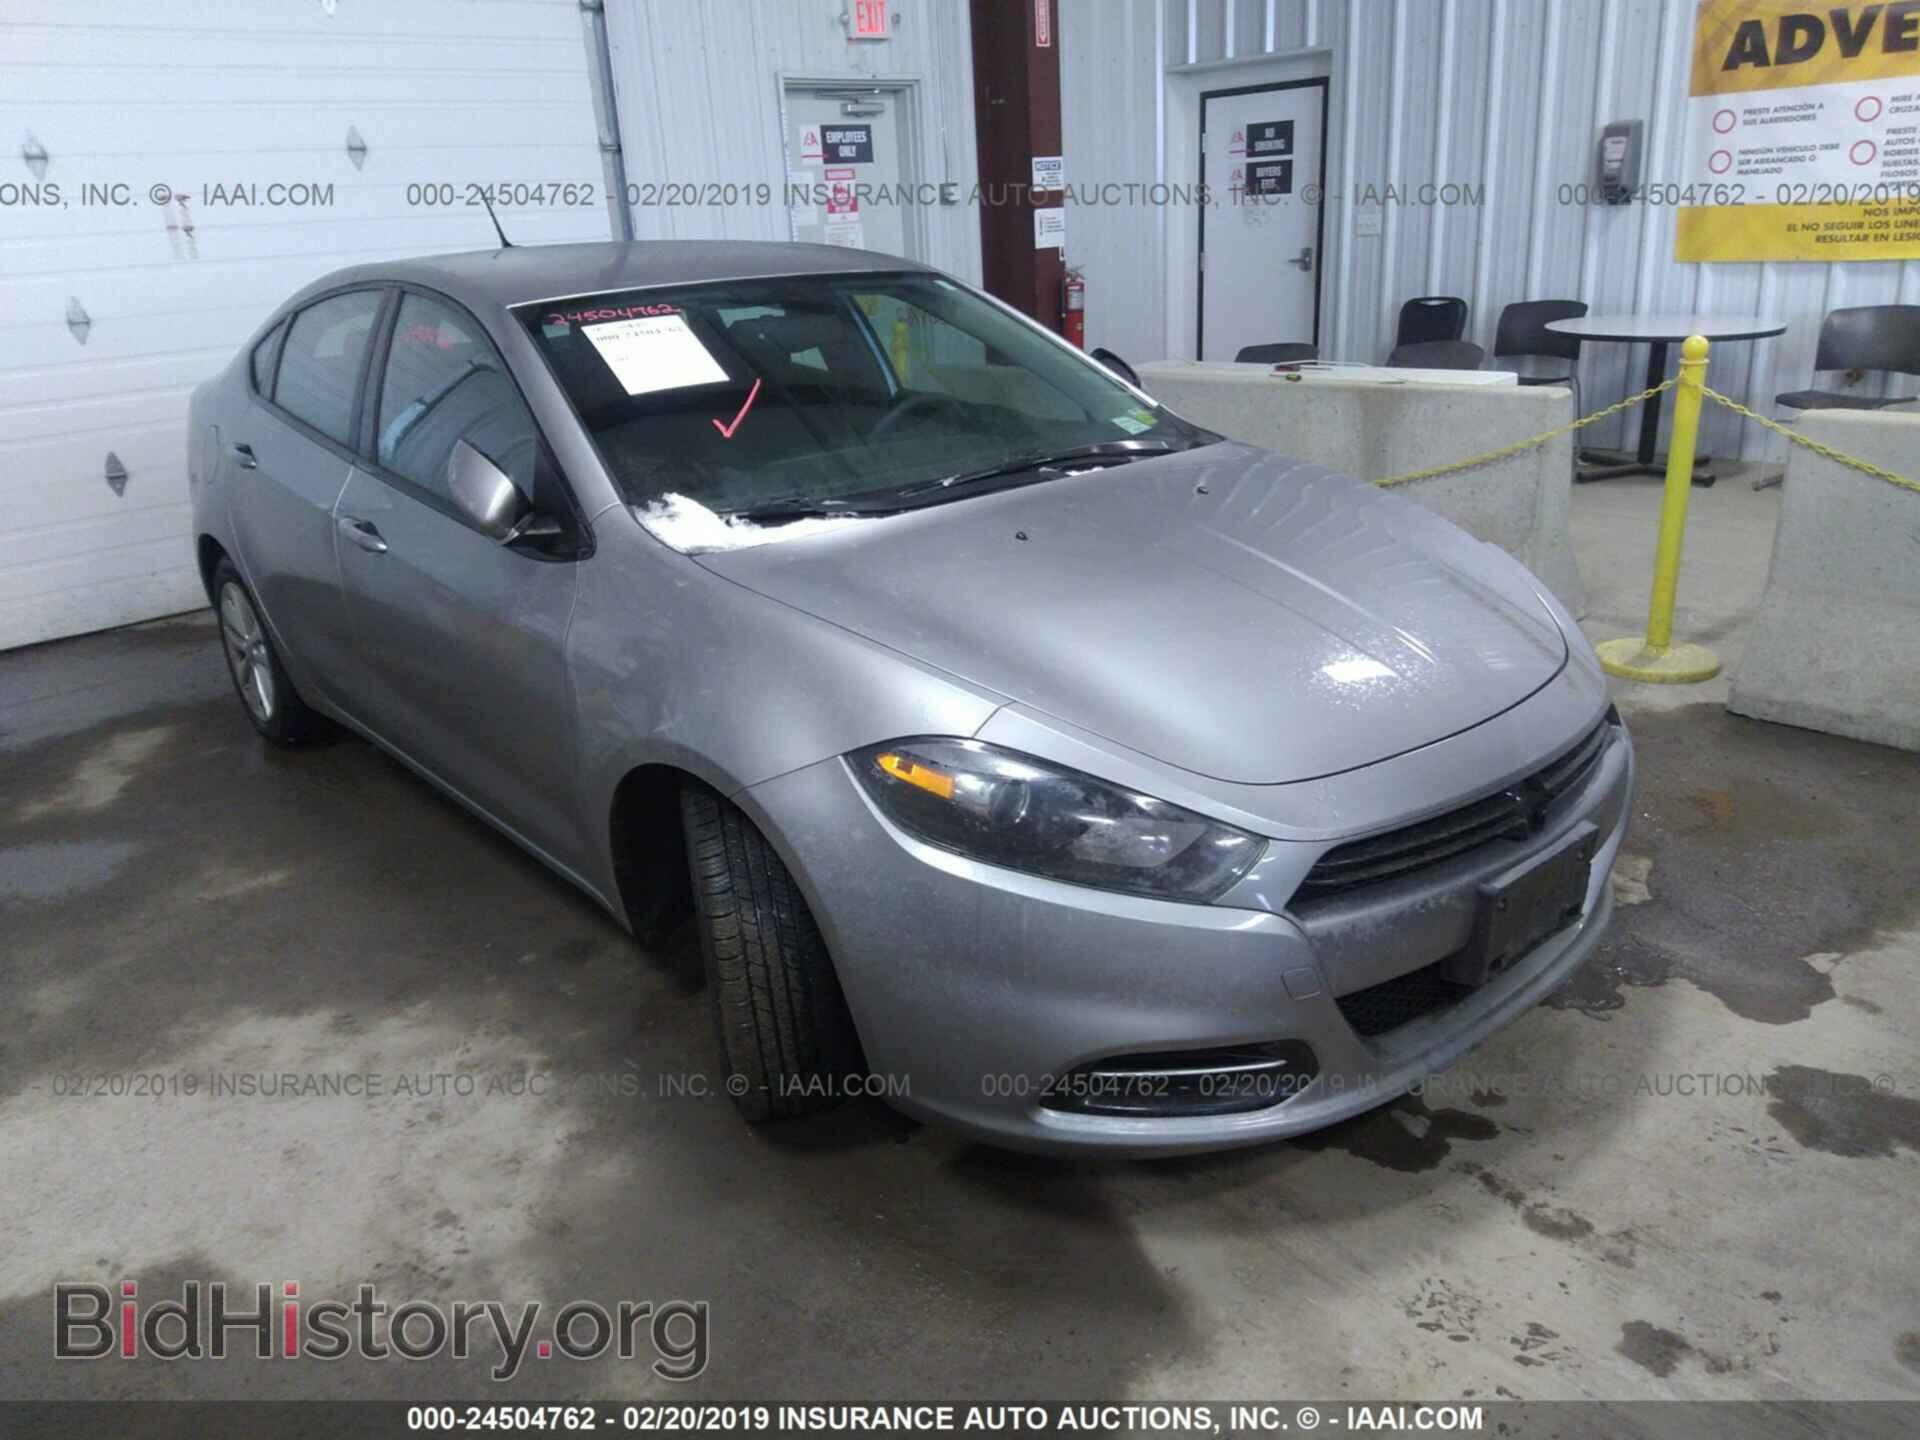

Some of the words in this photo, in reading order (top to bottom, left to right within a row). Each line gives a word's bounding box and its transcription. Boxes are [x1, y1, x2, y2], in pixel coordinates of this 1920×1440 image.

[856, 0, 885, 33] EXIT
[1721, 2, 1920, 71] ADVE
[1884, 138, 1915, 146] AUTOS
[1863, 207, 1889, 217] NOS
[1787, 223, 1798, 232] EL
[1801, 222, 1820, 231] NO
[1824, 221, 1864, 231] SEGUIR
[1868, 220, 1890, 230] LOS
[1815, 233, 1869, 243] RESULTAR
[1873, 232, 1889, 242] EN
[550, 303, 682, 325] 24504762
